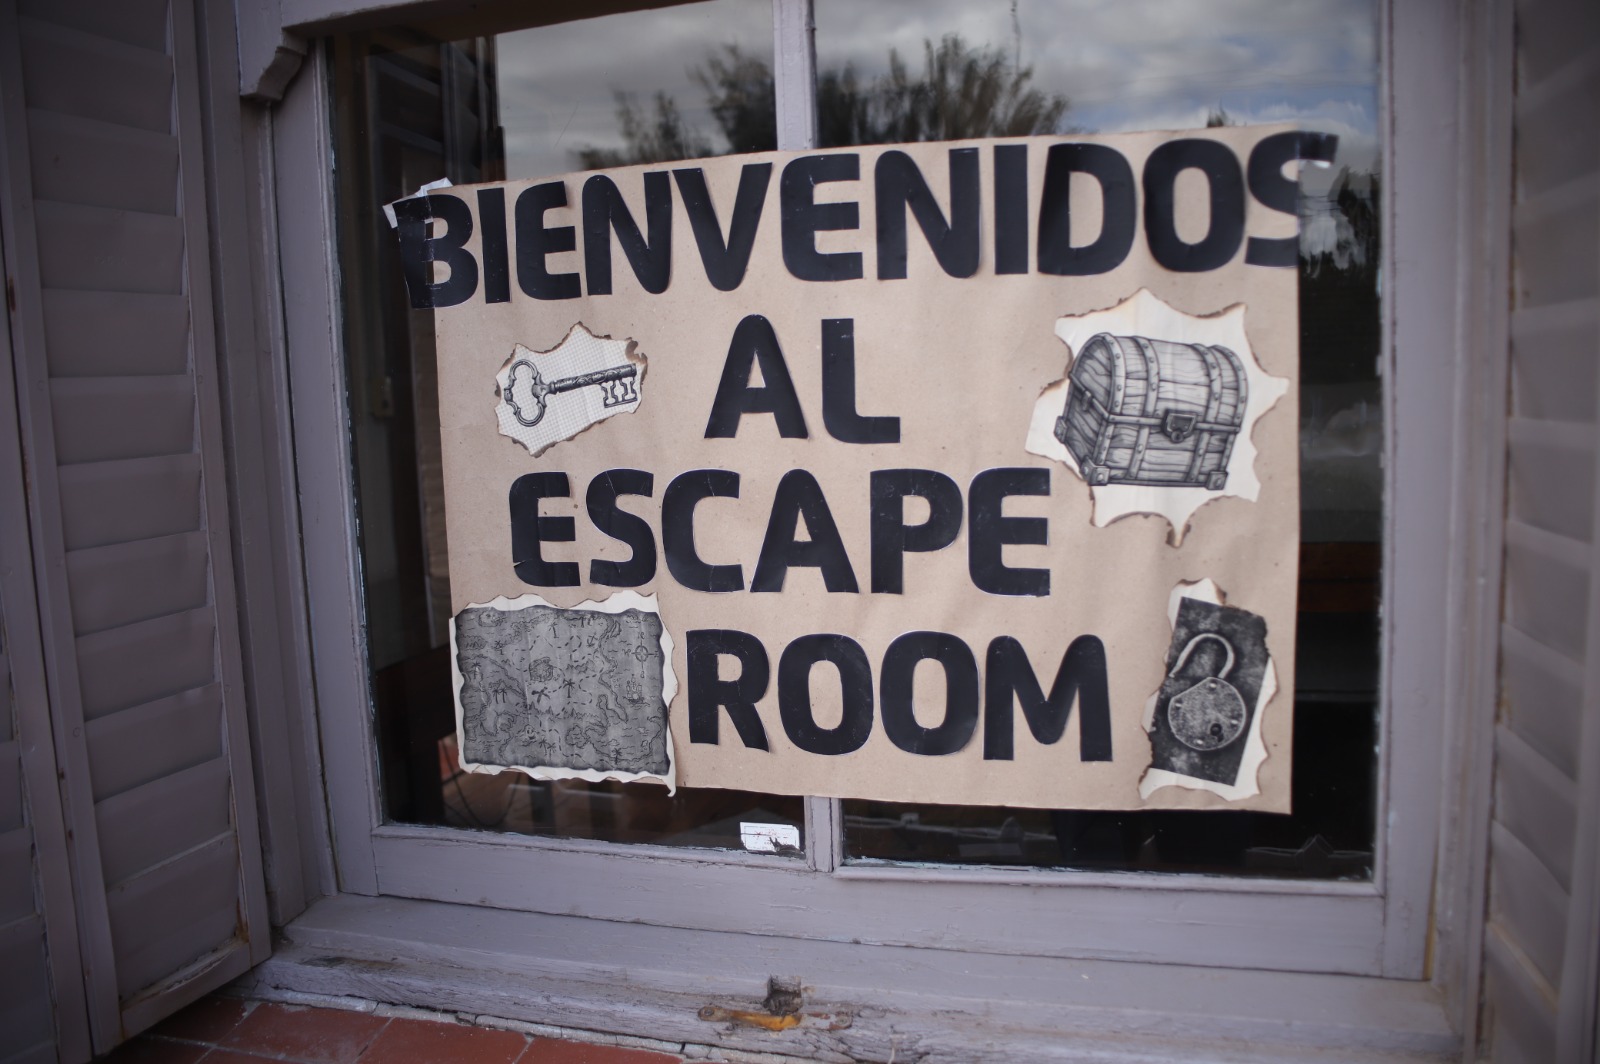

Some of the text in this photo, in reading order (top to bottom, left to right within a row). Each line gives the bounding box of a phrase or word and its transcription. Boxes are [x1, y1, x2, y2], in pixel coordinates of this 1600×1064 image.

[391, 130, 1339, 308] BIENVENIDOS
[704, 314, 900, 444] AL
[508, 468, 1050, 597] ESCAPE
[686, 628, 1113, 763] ROOM
